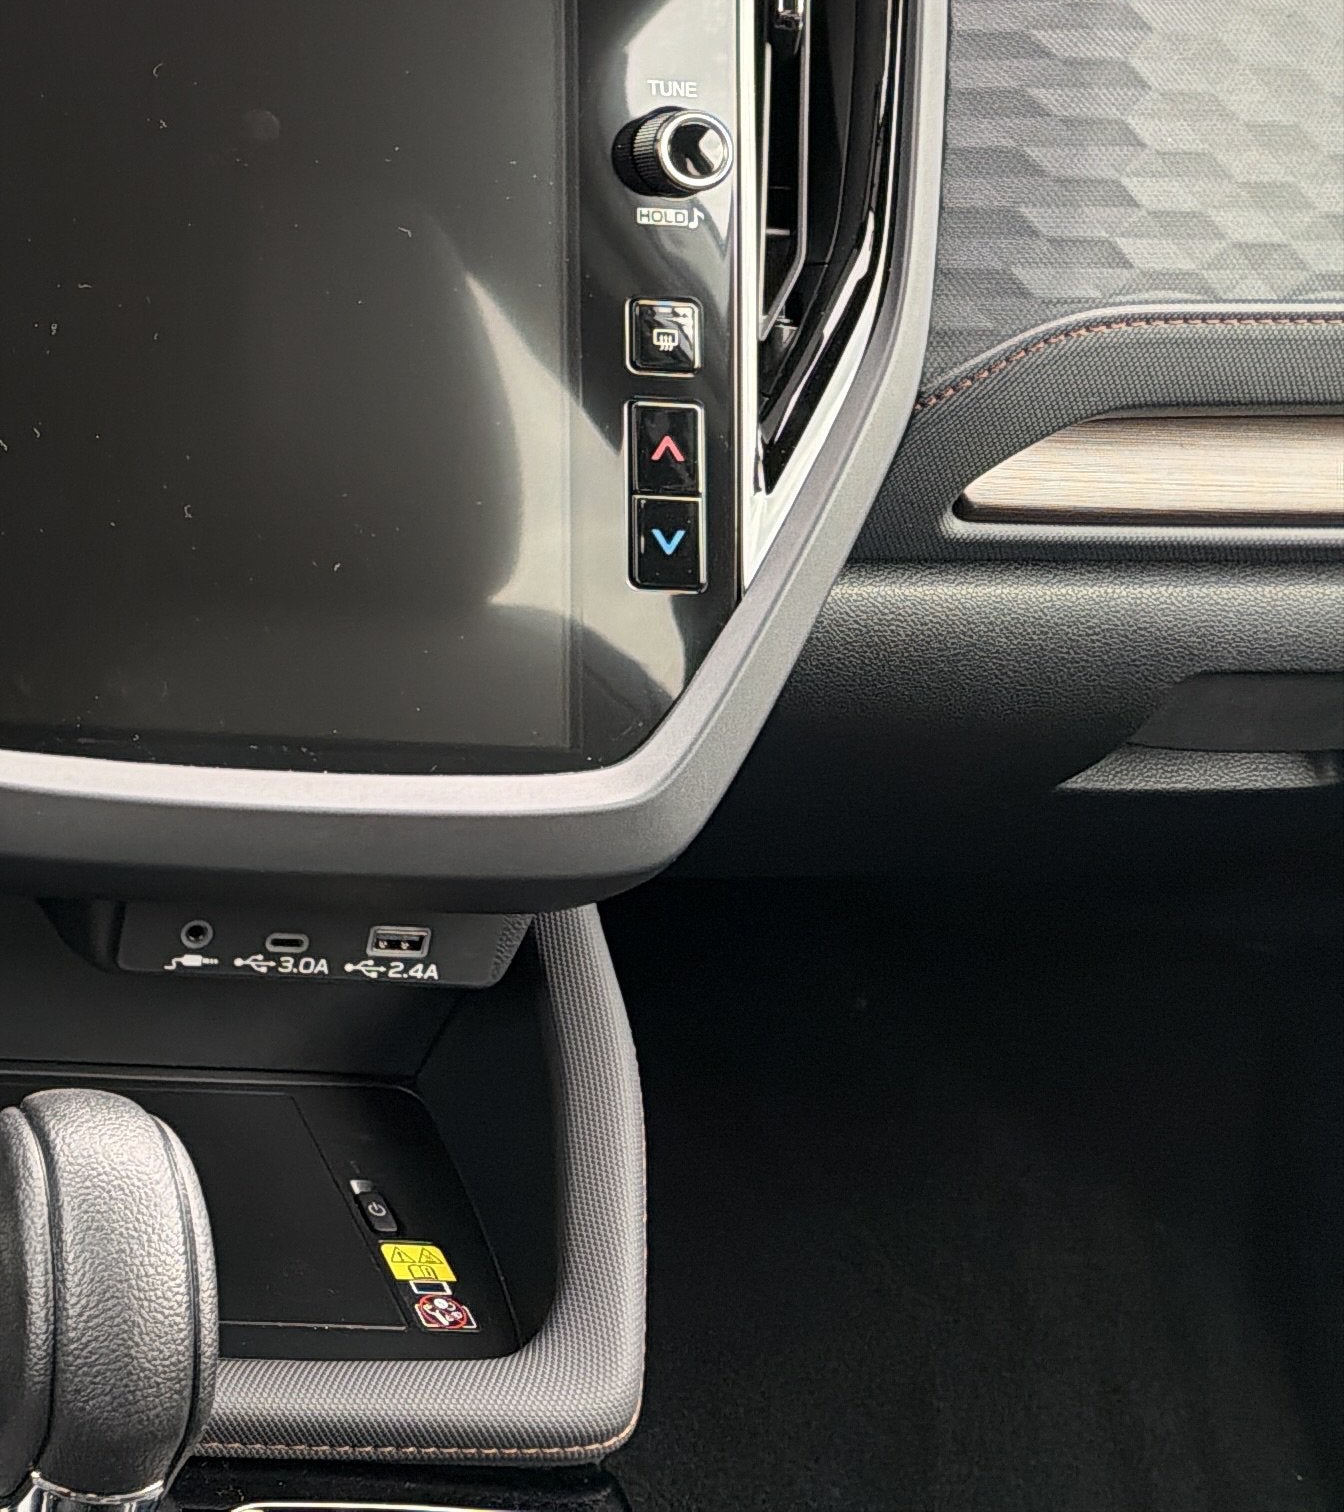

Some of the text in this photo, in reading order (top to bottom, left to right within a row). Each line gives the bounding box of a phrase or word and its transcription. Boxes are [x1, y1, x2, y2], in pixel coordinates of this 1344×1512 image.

[647, 79, 698, 98] TUNE
[637, 208, 688, 225] HOLD
[277, 956, 329, 975] 3.0A
[387, 961, 439, 981] 2.4A
